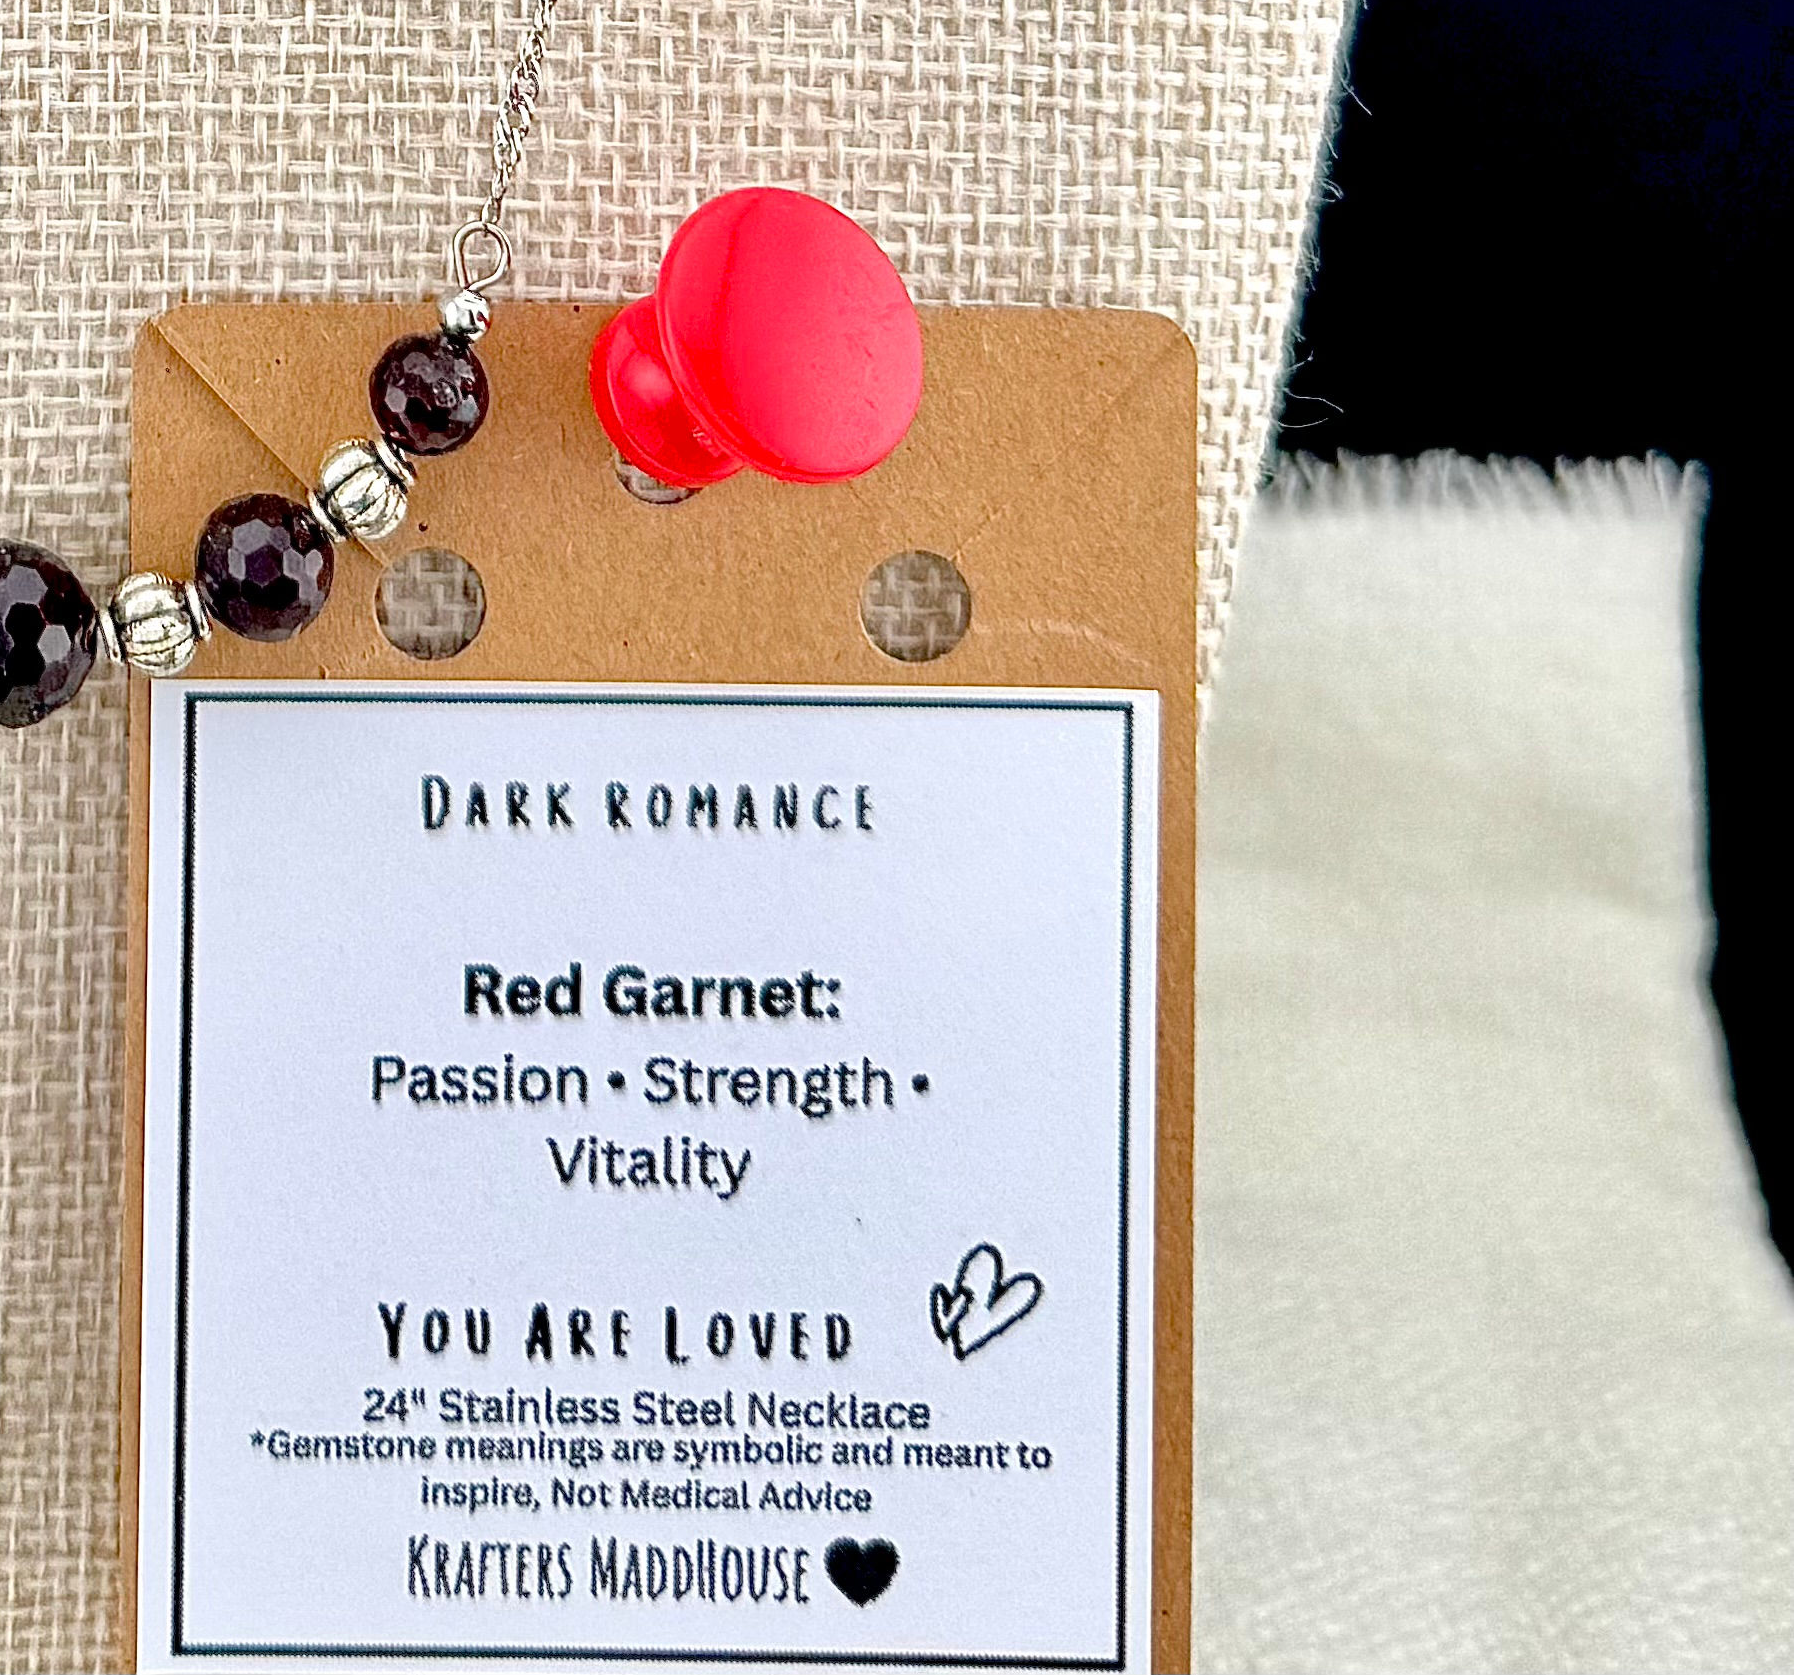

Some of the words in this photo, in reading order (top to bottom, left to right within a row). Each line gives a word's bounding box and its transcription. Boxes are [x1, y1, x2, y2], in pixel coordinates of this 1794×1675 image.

[420, 773, 573, 831] DARK
[605, 780, 873, 832] ROMANCE
[463, 961, 582, 1016] Red
[602, 965, 842, 1019] Garnet:
[371, 1053, 588, 1104] Passion
[643, 1055, 894, 1119] Strength
[545, 1135, 752, 1202] Vitality
[377, 1301, 491, 1359] YOU
[524, 1301, 632, 1361] ARE
[664, 1305, 852, 1365] LOVED
[362, 1386, 427, 1424] 24"
[438, 1386, 620, 1427] Stainless
[632, 1388, 735, 1428] Steel
[747, 1391, 932, 1430] Necklace
[445, 1430, 604, 1469] meanings
[611, 1438, 664, 1463] are
[672, 1433, 824, 1472] symbolic
[831, 1435, 895, 1465] and
[904, 1440, 1010, 1468] meant
[1017, 1441, 1053, 1470] to
[420, 1475, 541, 1514] inspire,
[551, 1477, 611, 1508] Not
[620, 1478, 751, 1511] Medical
[758, 1481, 873, 1512] Advice
